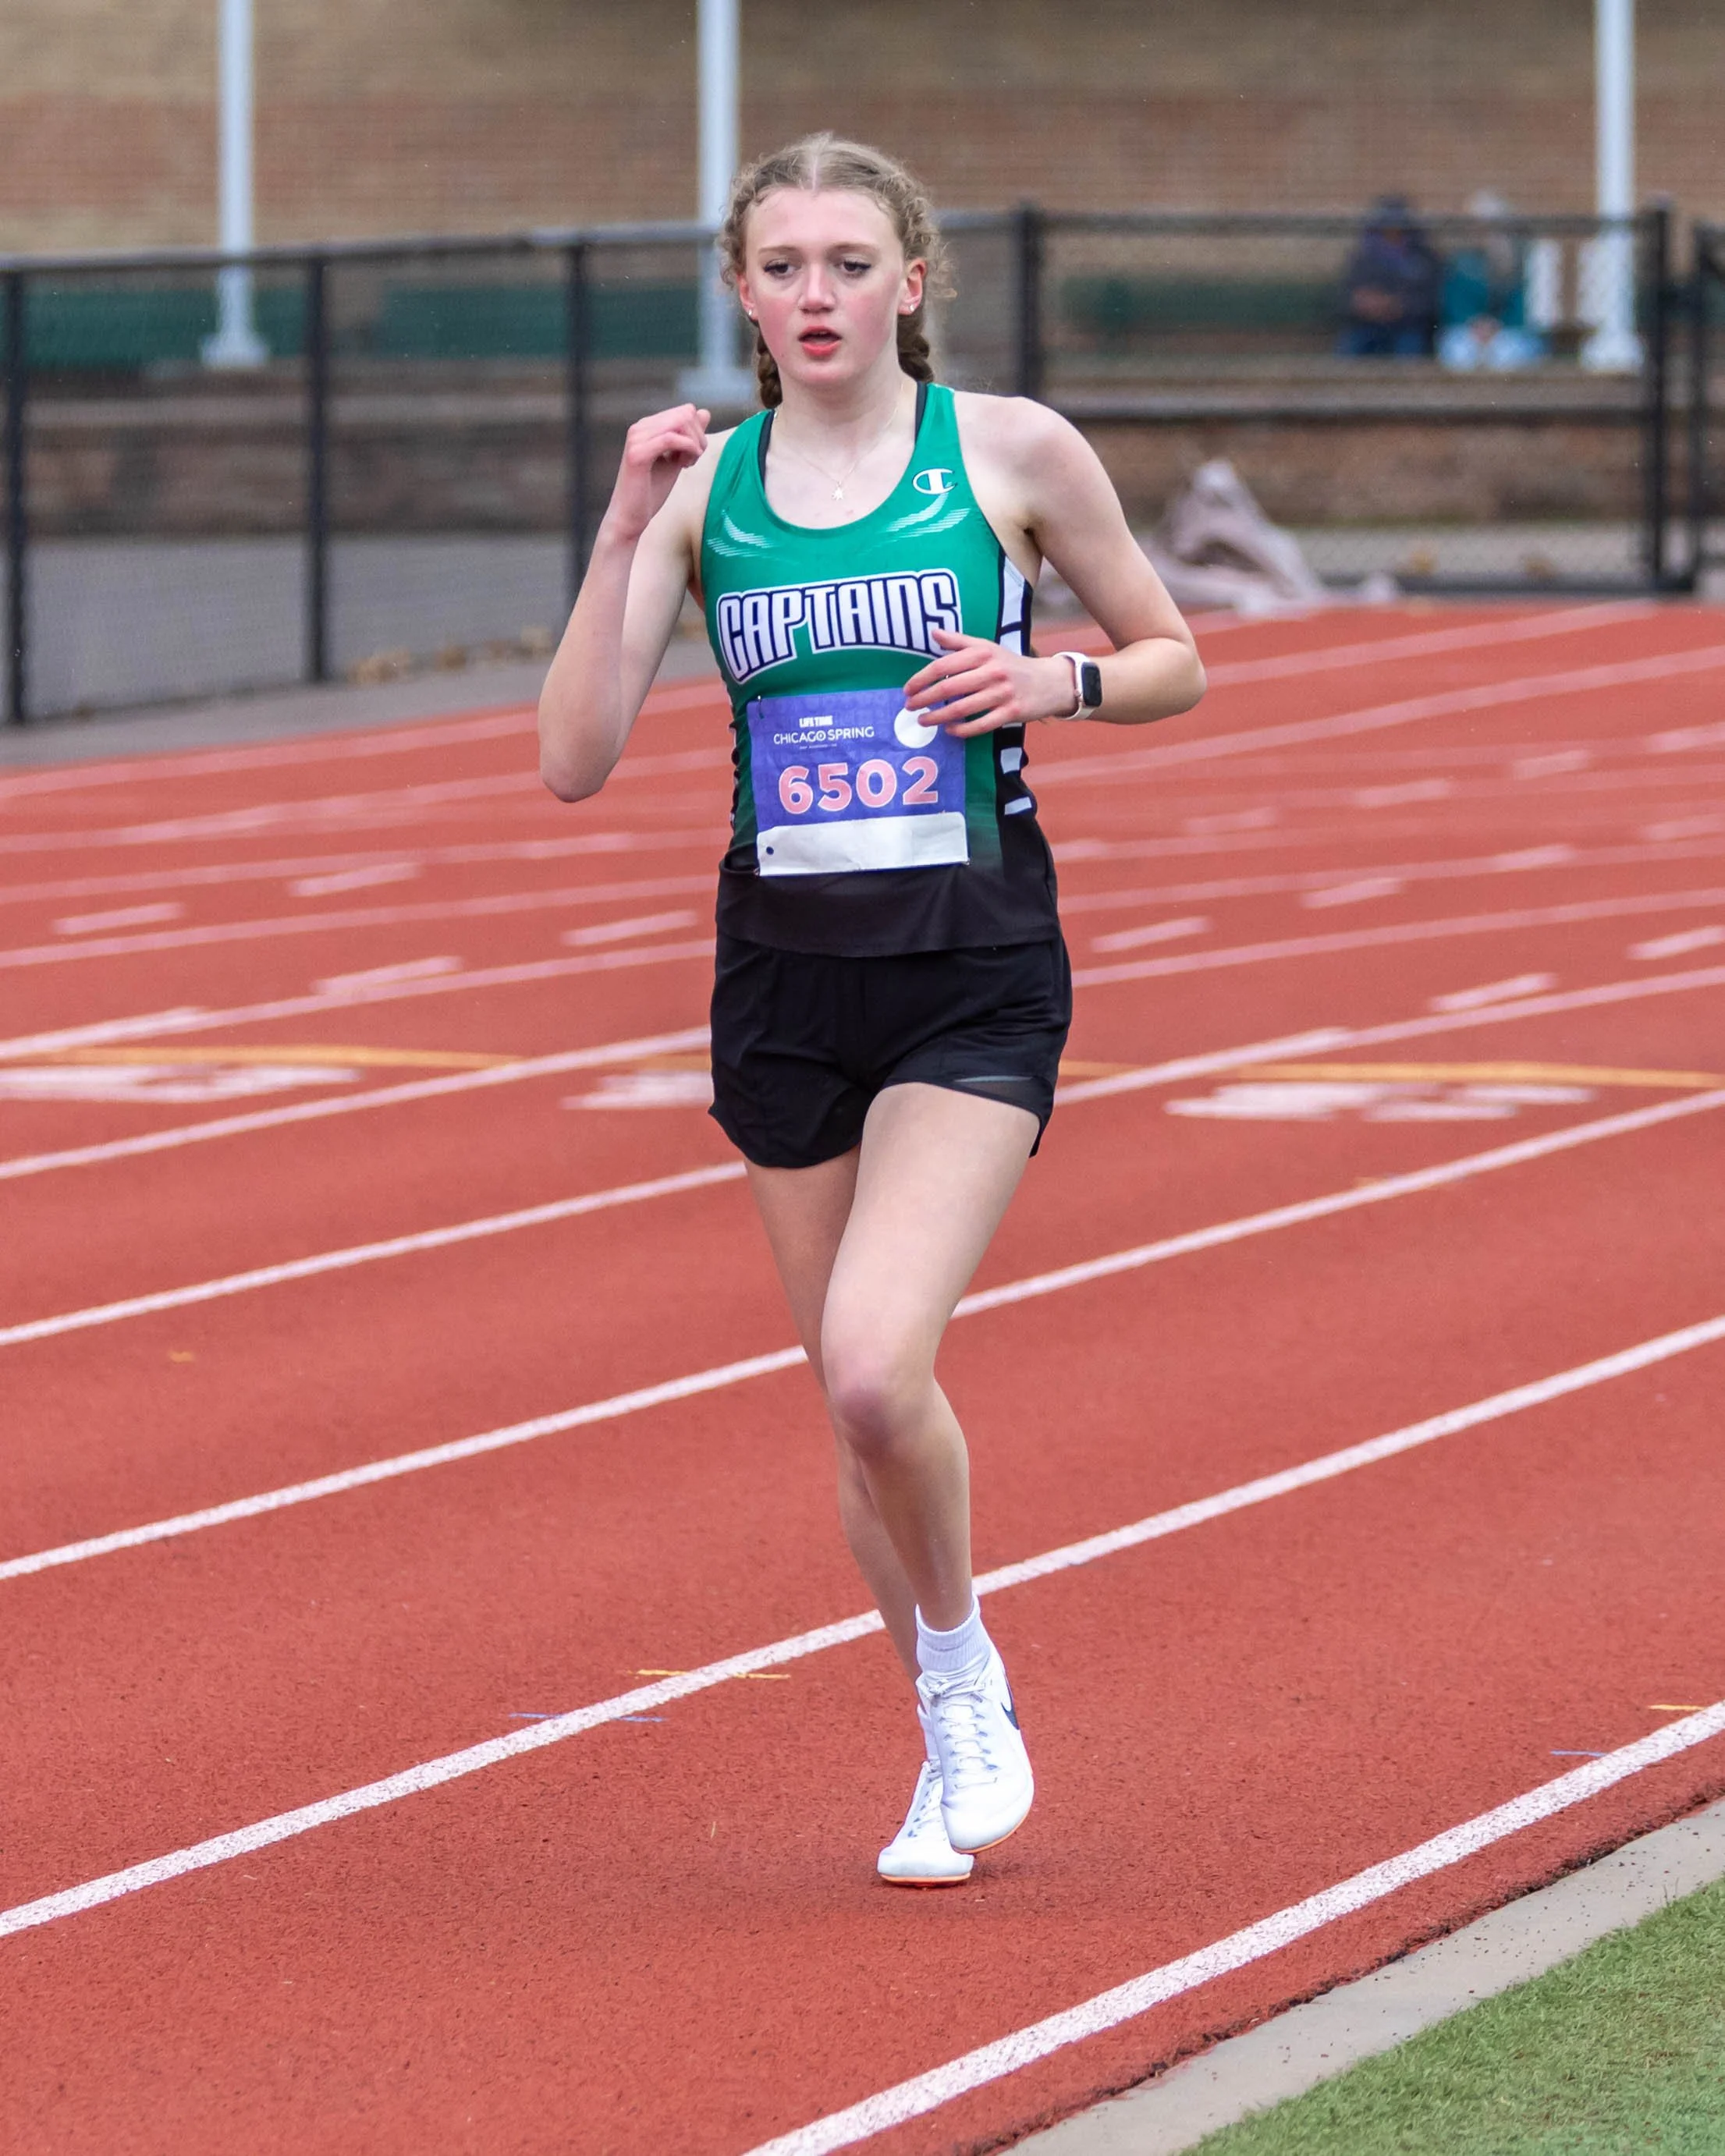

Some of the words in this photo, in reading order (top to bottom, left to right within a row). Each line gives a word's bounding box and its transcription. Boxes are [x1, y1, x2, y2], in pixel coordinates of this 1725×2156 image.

[719, 570, 960, 683] CAPTAINS
[773, 730, 826, 745] CHICAGO
[827, 726, 875, 741] SPRING
[779, 756, 939, 815] 6502
